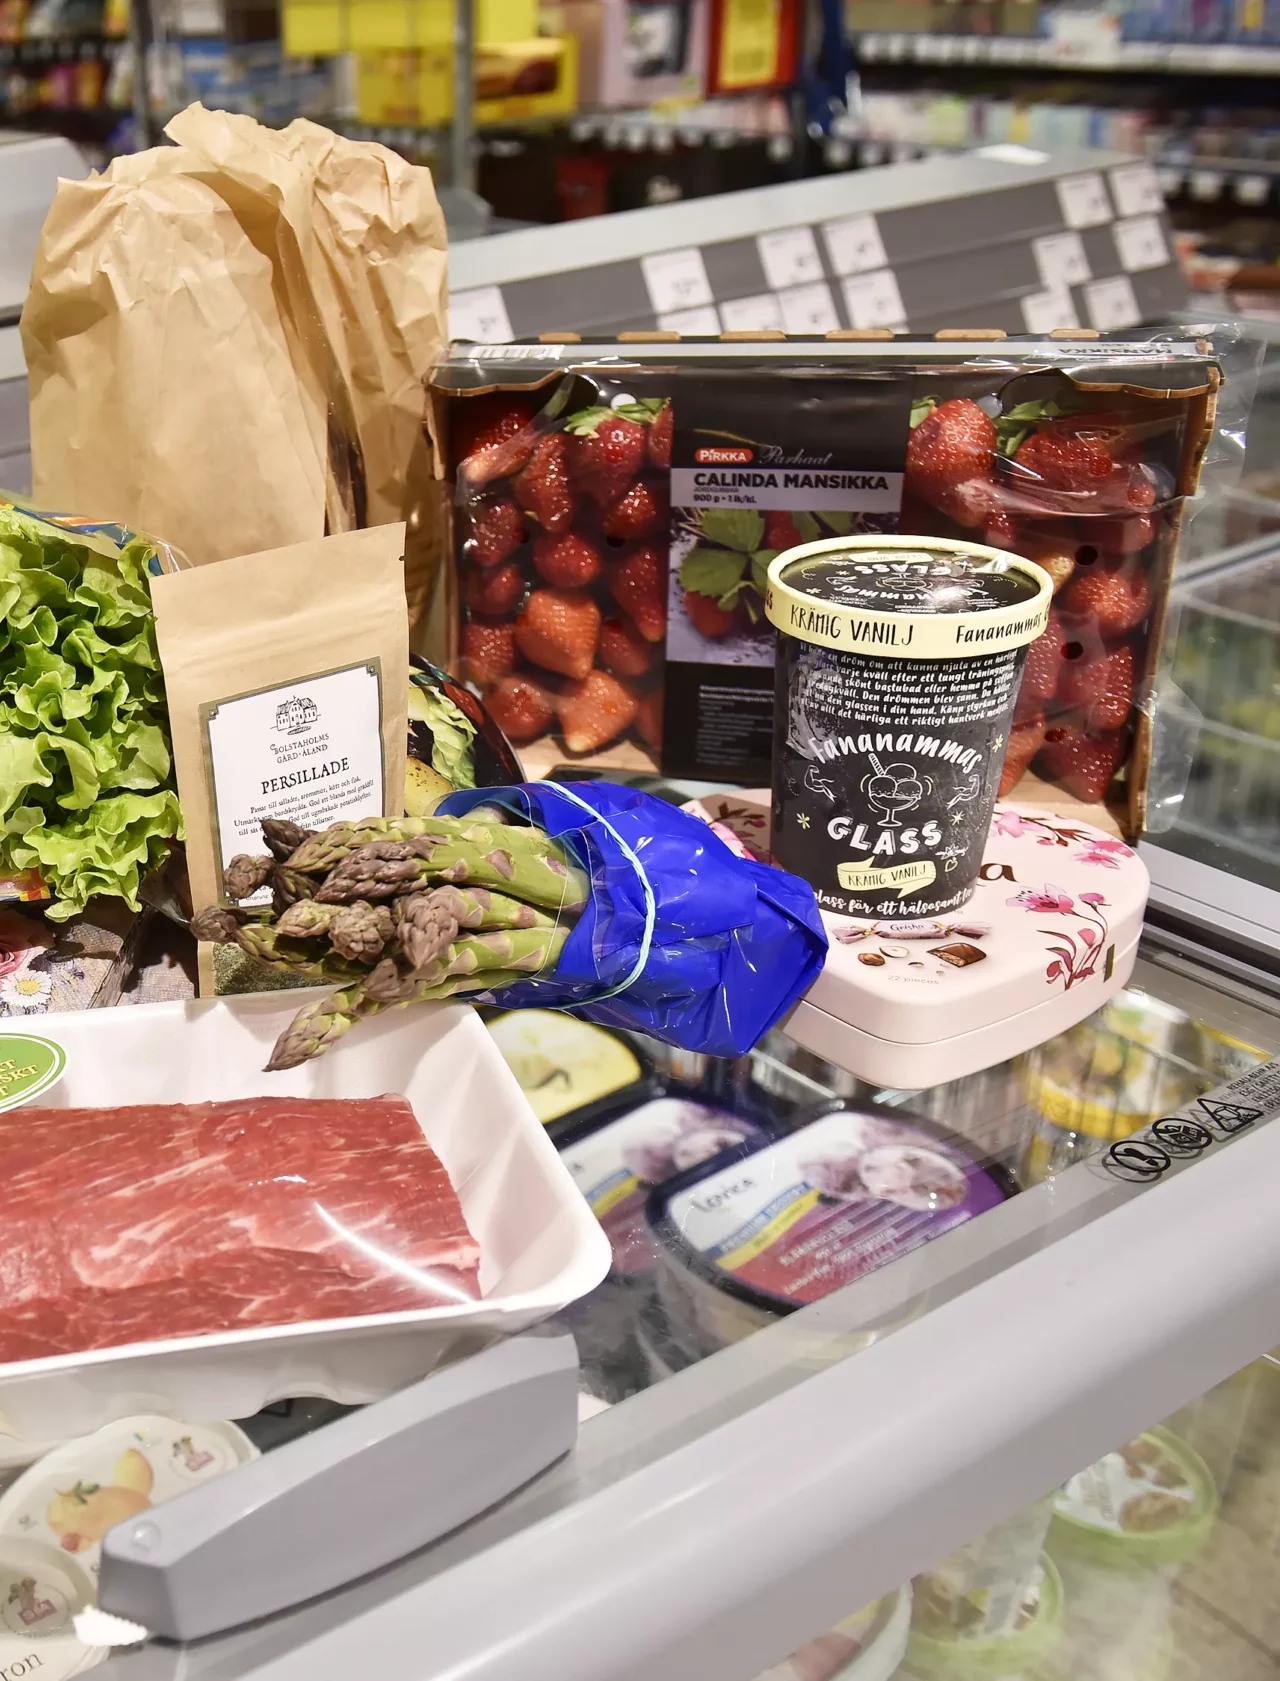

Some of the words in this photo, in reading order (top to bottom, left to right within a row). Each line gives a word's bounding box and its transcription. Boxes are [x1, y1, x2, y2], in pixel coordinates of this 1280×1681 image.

[759, 445, 833, 466] Parhaat
[694, 473, 778, 488] CALINDA
[784, 474, 889, 490] MANSIKKA
[790, 604, 842, 639] KRÄMIG
[850, 620, 914, 646] VANILJ
[956, 612, 1042, 644] Fananammas
[837, 666, 860, 677] varje
[863, 669, 889, 681] kväll
[891, 672, 917, 682] efter
[920, 673, 935, 682] ett
[938, 672, 965, 684] tungt
[841, 655, 865, 667] dröm
[869, 661, 884, 669] om
[887, 661, 903, 671] att
[907, 662, 939, 671] kunna
[942, 659, 969, 673] njuta
[971, 660, 982, 669] av
[984, 658, 993, 666] en
[845, 678, 871, 689] skönt
[874, 681, 922, 693] bastubad
[924, 684, 947, 693] eller
[950, 682, 980, 693] hemma
[982, 677, 993, 689] på
[862, 691, 880, 702] Den
[883, 693, 930, 704] drömmen
[933, 694, 954, 704] blev
[956, 692, 979, 703] sann.
[981, 688, 991, 699] Du
[821, 704, 836, 716] allt
[837, 708, 852, 719] det
[854, 711, 891, 725] härliga
[894, 716, 909, 726] ett
[911, 716, 946, 727] riktigt
[948, 712, 985, 724] hantverk
[827, 695, 842, 706] den
[845, 700, 880, 712] glassen
[890, 705, 907, 714] din
[910, 706, 937, 715] hand.
[808, 733, 983, 774] Fananammas
[261, 757, 350, 795] PERSILLADE
[268, 801, 277, 809] till
[341, 779, 351, 788] och
[234, 815, 261, 827] Utmärkt
[308, 799, 320, 807] God
[330, 789, 346, 801] blanda
[347, 788, 357, 796] med
[239, 828, 249, 836] till
[289, 815, 300, 823] God
[301, 811, 311, 820] till
[827, 816, 943, 855] GLASS
[890, 863, 926, 882] VANILJ
[848, 898, 874, 914] för
[877, 899, 898, 915] ett
[899, 892, 961, 914] hälsosamt
[887, 974, 900, 982] 22
[903, 975, 939, 985] pieces
